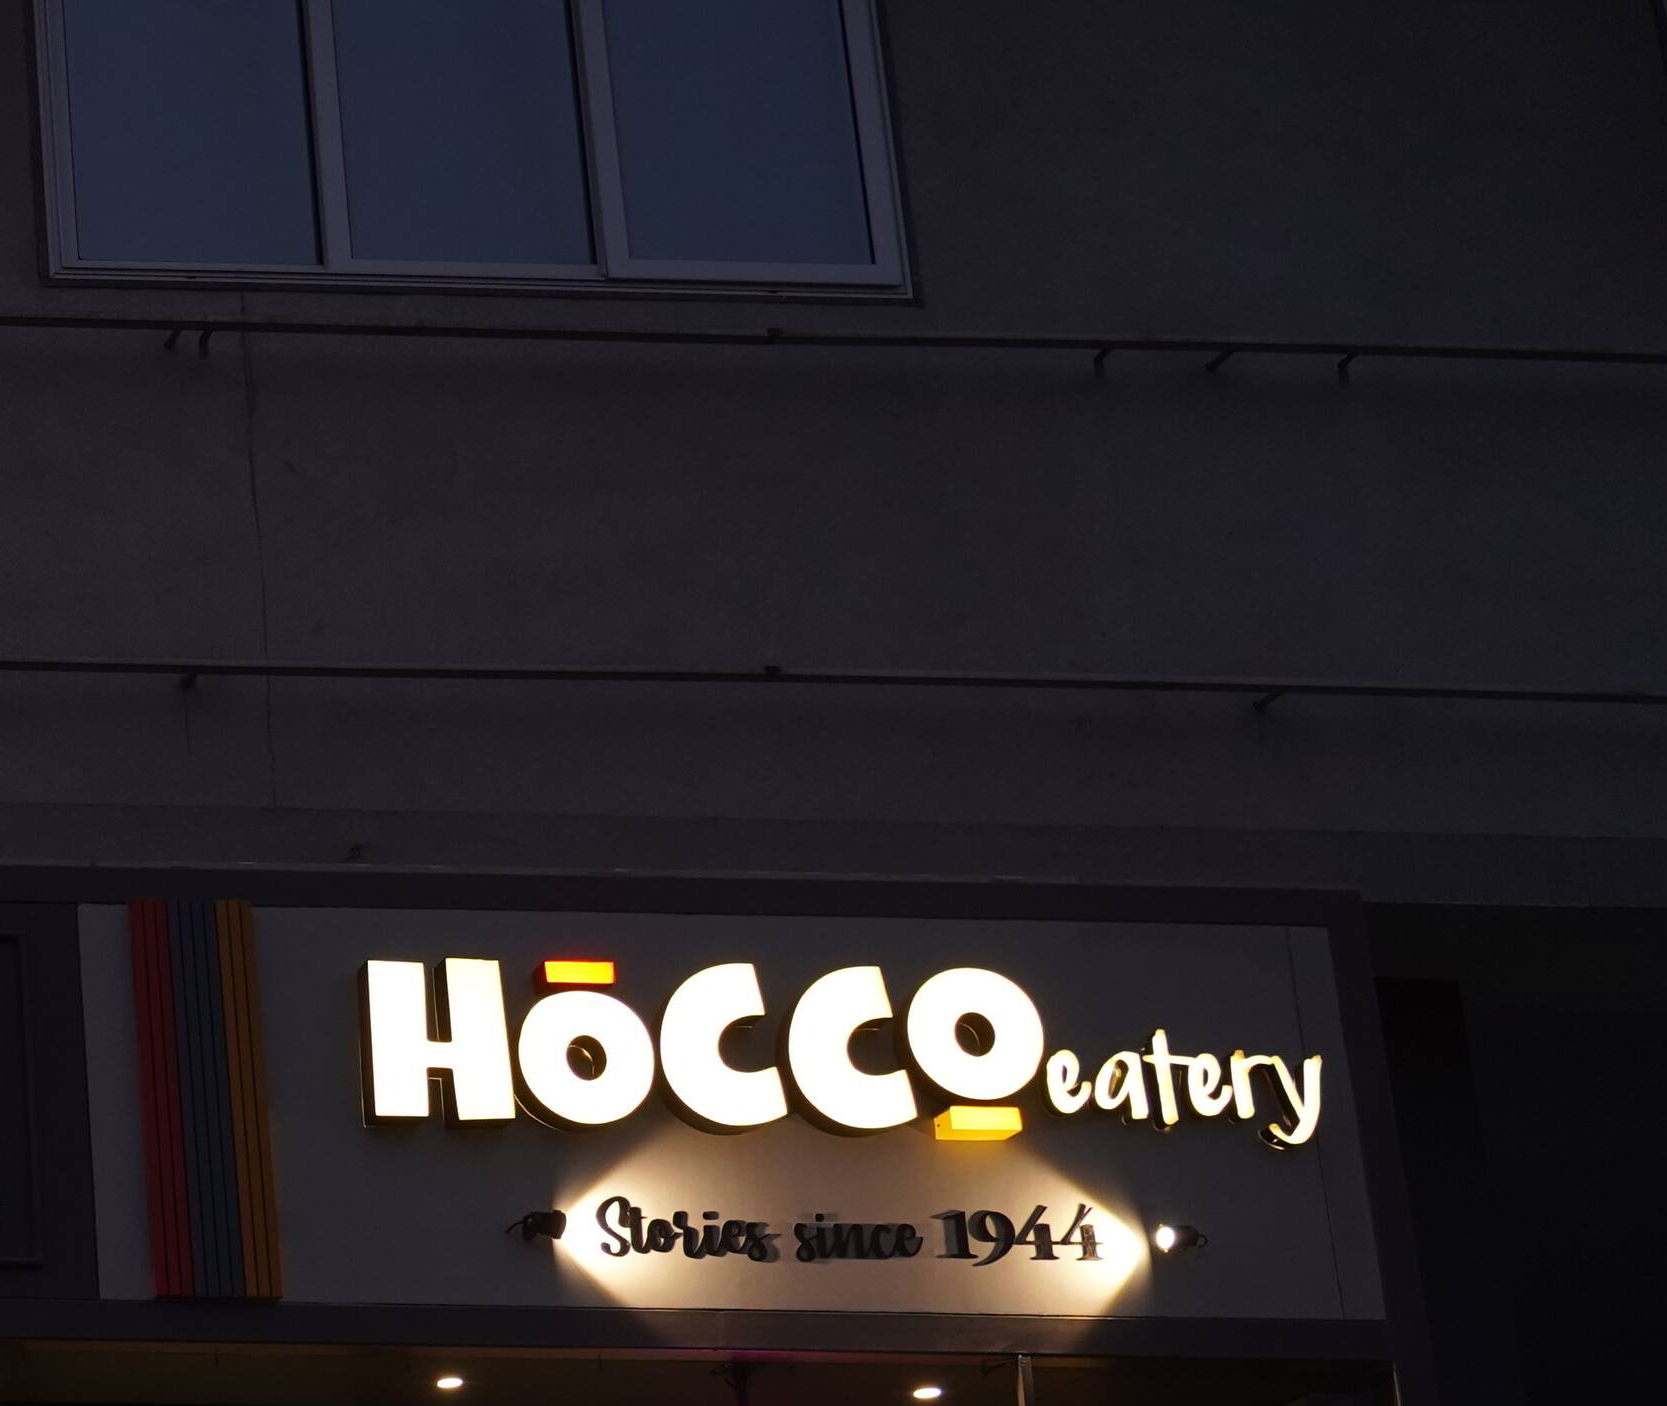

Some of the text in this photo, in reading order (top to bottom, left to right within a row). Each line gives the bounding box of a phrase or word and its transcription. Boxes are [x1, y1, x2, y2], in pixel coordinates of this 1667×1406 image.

[1044, 1028, 1323, 1149] eatery
[595, 1195, 1104, 1263] Stories since 1944
